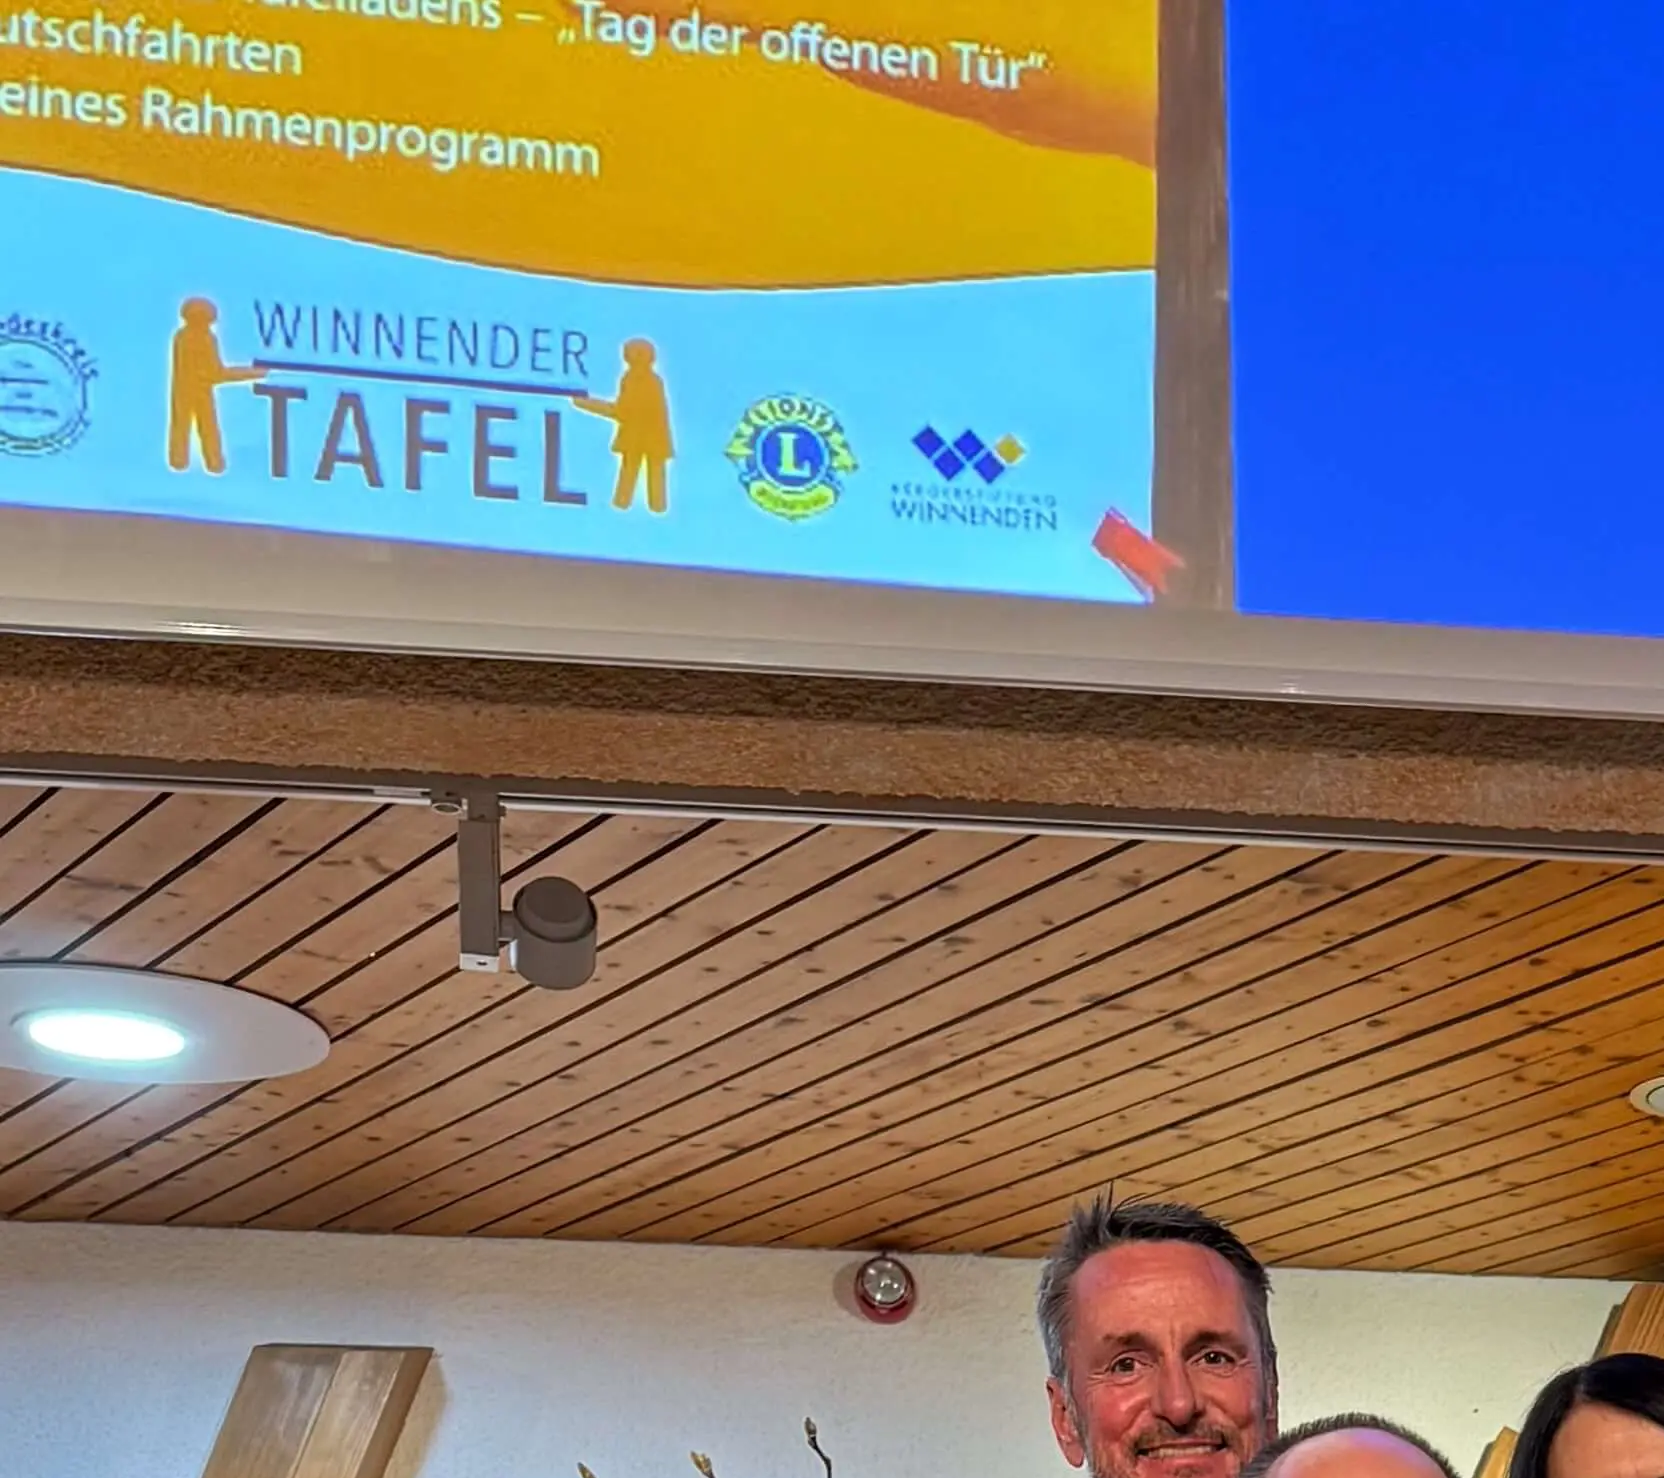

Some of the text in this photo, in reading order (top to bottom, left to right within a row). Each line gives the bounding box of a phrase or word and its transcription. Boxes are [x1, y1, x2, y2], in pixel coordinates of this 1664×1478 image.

[557, 1, 654, 57] „Tag
[669, 8, 749, 55] der
[761, 23, 938, 80] offenen
[949, 41, 1048, 90] Tür“
[142, 84, 600, 176] Rahmenprogramm
[253, 300, 589, 377] WINNENDER
[253, 382, 588, 507] TAFEL
[777, 431, 811, 478] L
